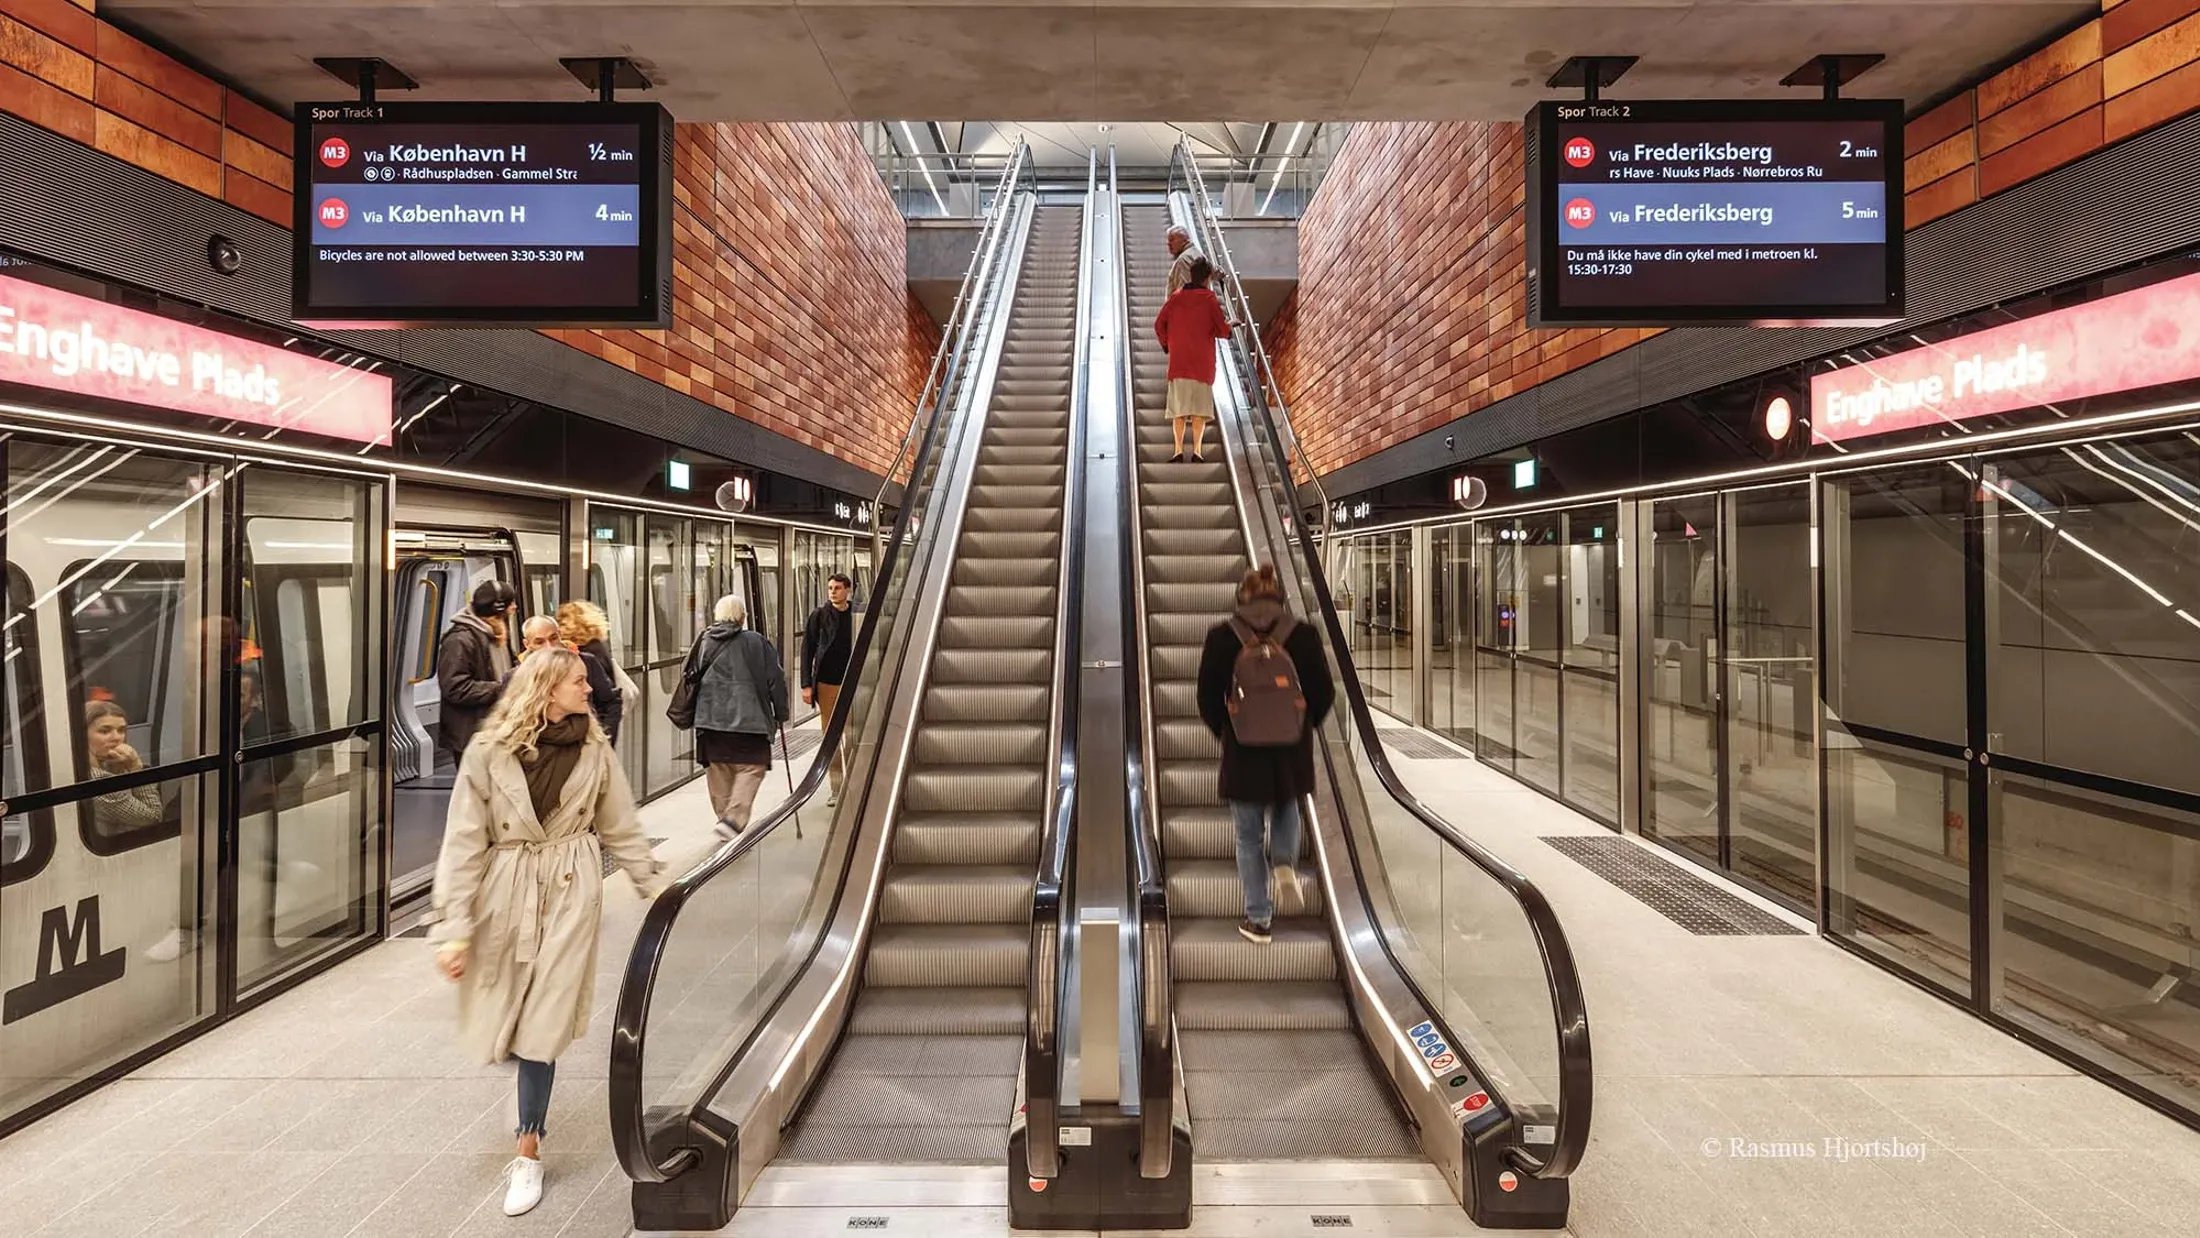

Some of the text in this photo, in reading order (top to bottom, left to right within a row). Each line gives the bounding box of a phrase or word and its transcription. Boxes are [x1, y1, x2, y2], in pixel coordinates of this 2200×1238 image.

[312, 107, 383, 121] Spor Track 1
[1558, 106, 1630, 119] Spor Track 2
[323, 146, 346, 159] M3
[364, 151, 384, 162] Via
[389, 144, 505, 162] København
[511, 145, 526, 162] H
[610, 149, 633, 161] min
[1568, 141, 1878, 165] M3 Via Frederiksberg 2 min
[403, 167, 494, 182] Rådhuspladsen
[502, 167, 553, 179] Gammel
[1609, 166, 1823, 178] rs Have Nuuks Plads Nørrebros Ru
[322, 204, 633, 223] M3 Via København H 4 min
[1568, 202, 1878, 226] M3 Via Frederiksberg 5 min
[319, 250, 584, 264] Bicycles are not allowed between 3:30-5:30 PM
[1567, 248, 1818, 263] Du må ikke have din cykel med i metroen kl.
[1567, 264, 1632, 276] 15:30-17:30
[191, 351, 281, 406] Plads
[1826, 343, 2046, 426] Enghave Plads
[847, 1218, 889, 1227] KONE
